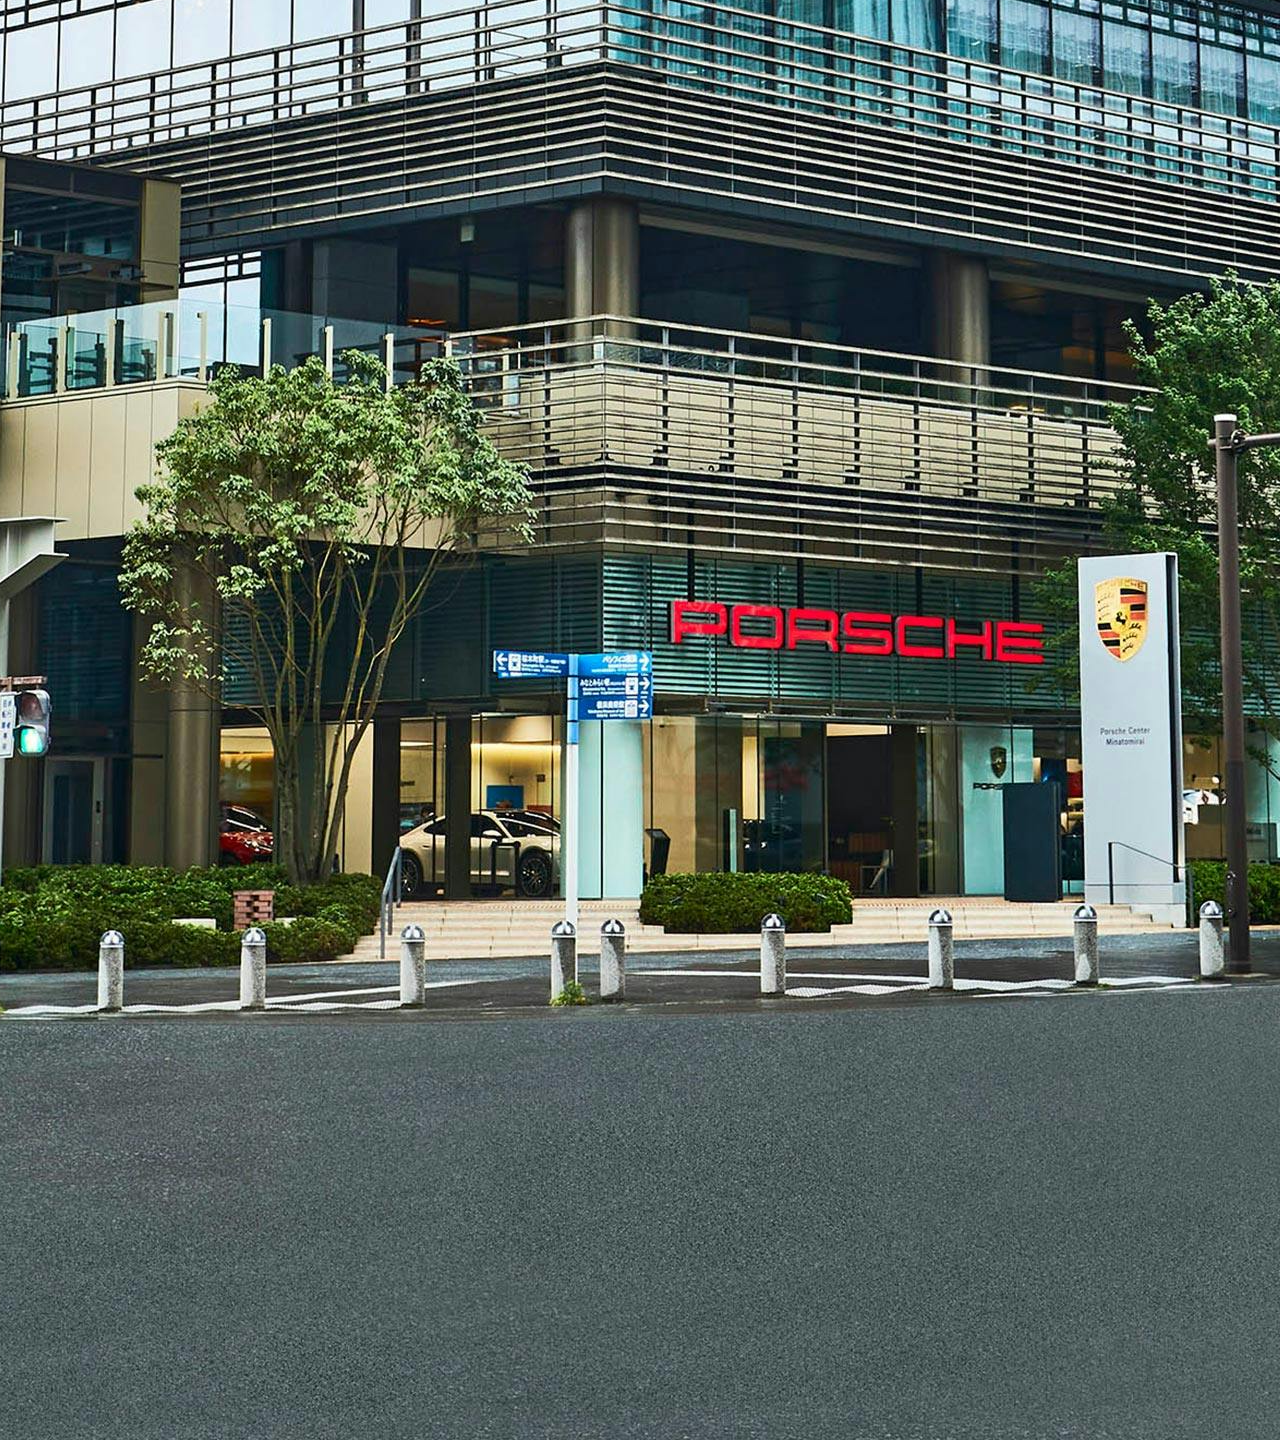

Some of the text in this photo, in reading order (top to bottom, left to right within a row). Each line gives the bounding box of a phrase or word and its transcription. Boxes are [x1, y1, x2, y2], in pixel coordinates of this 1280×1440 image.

[673, 600, 1044, 664] PORSCHE
[1100, 726, 1150, 735] Porsche Center
[1106, 737, 1145, 745] Minatomirai
